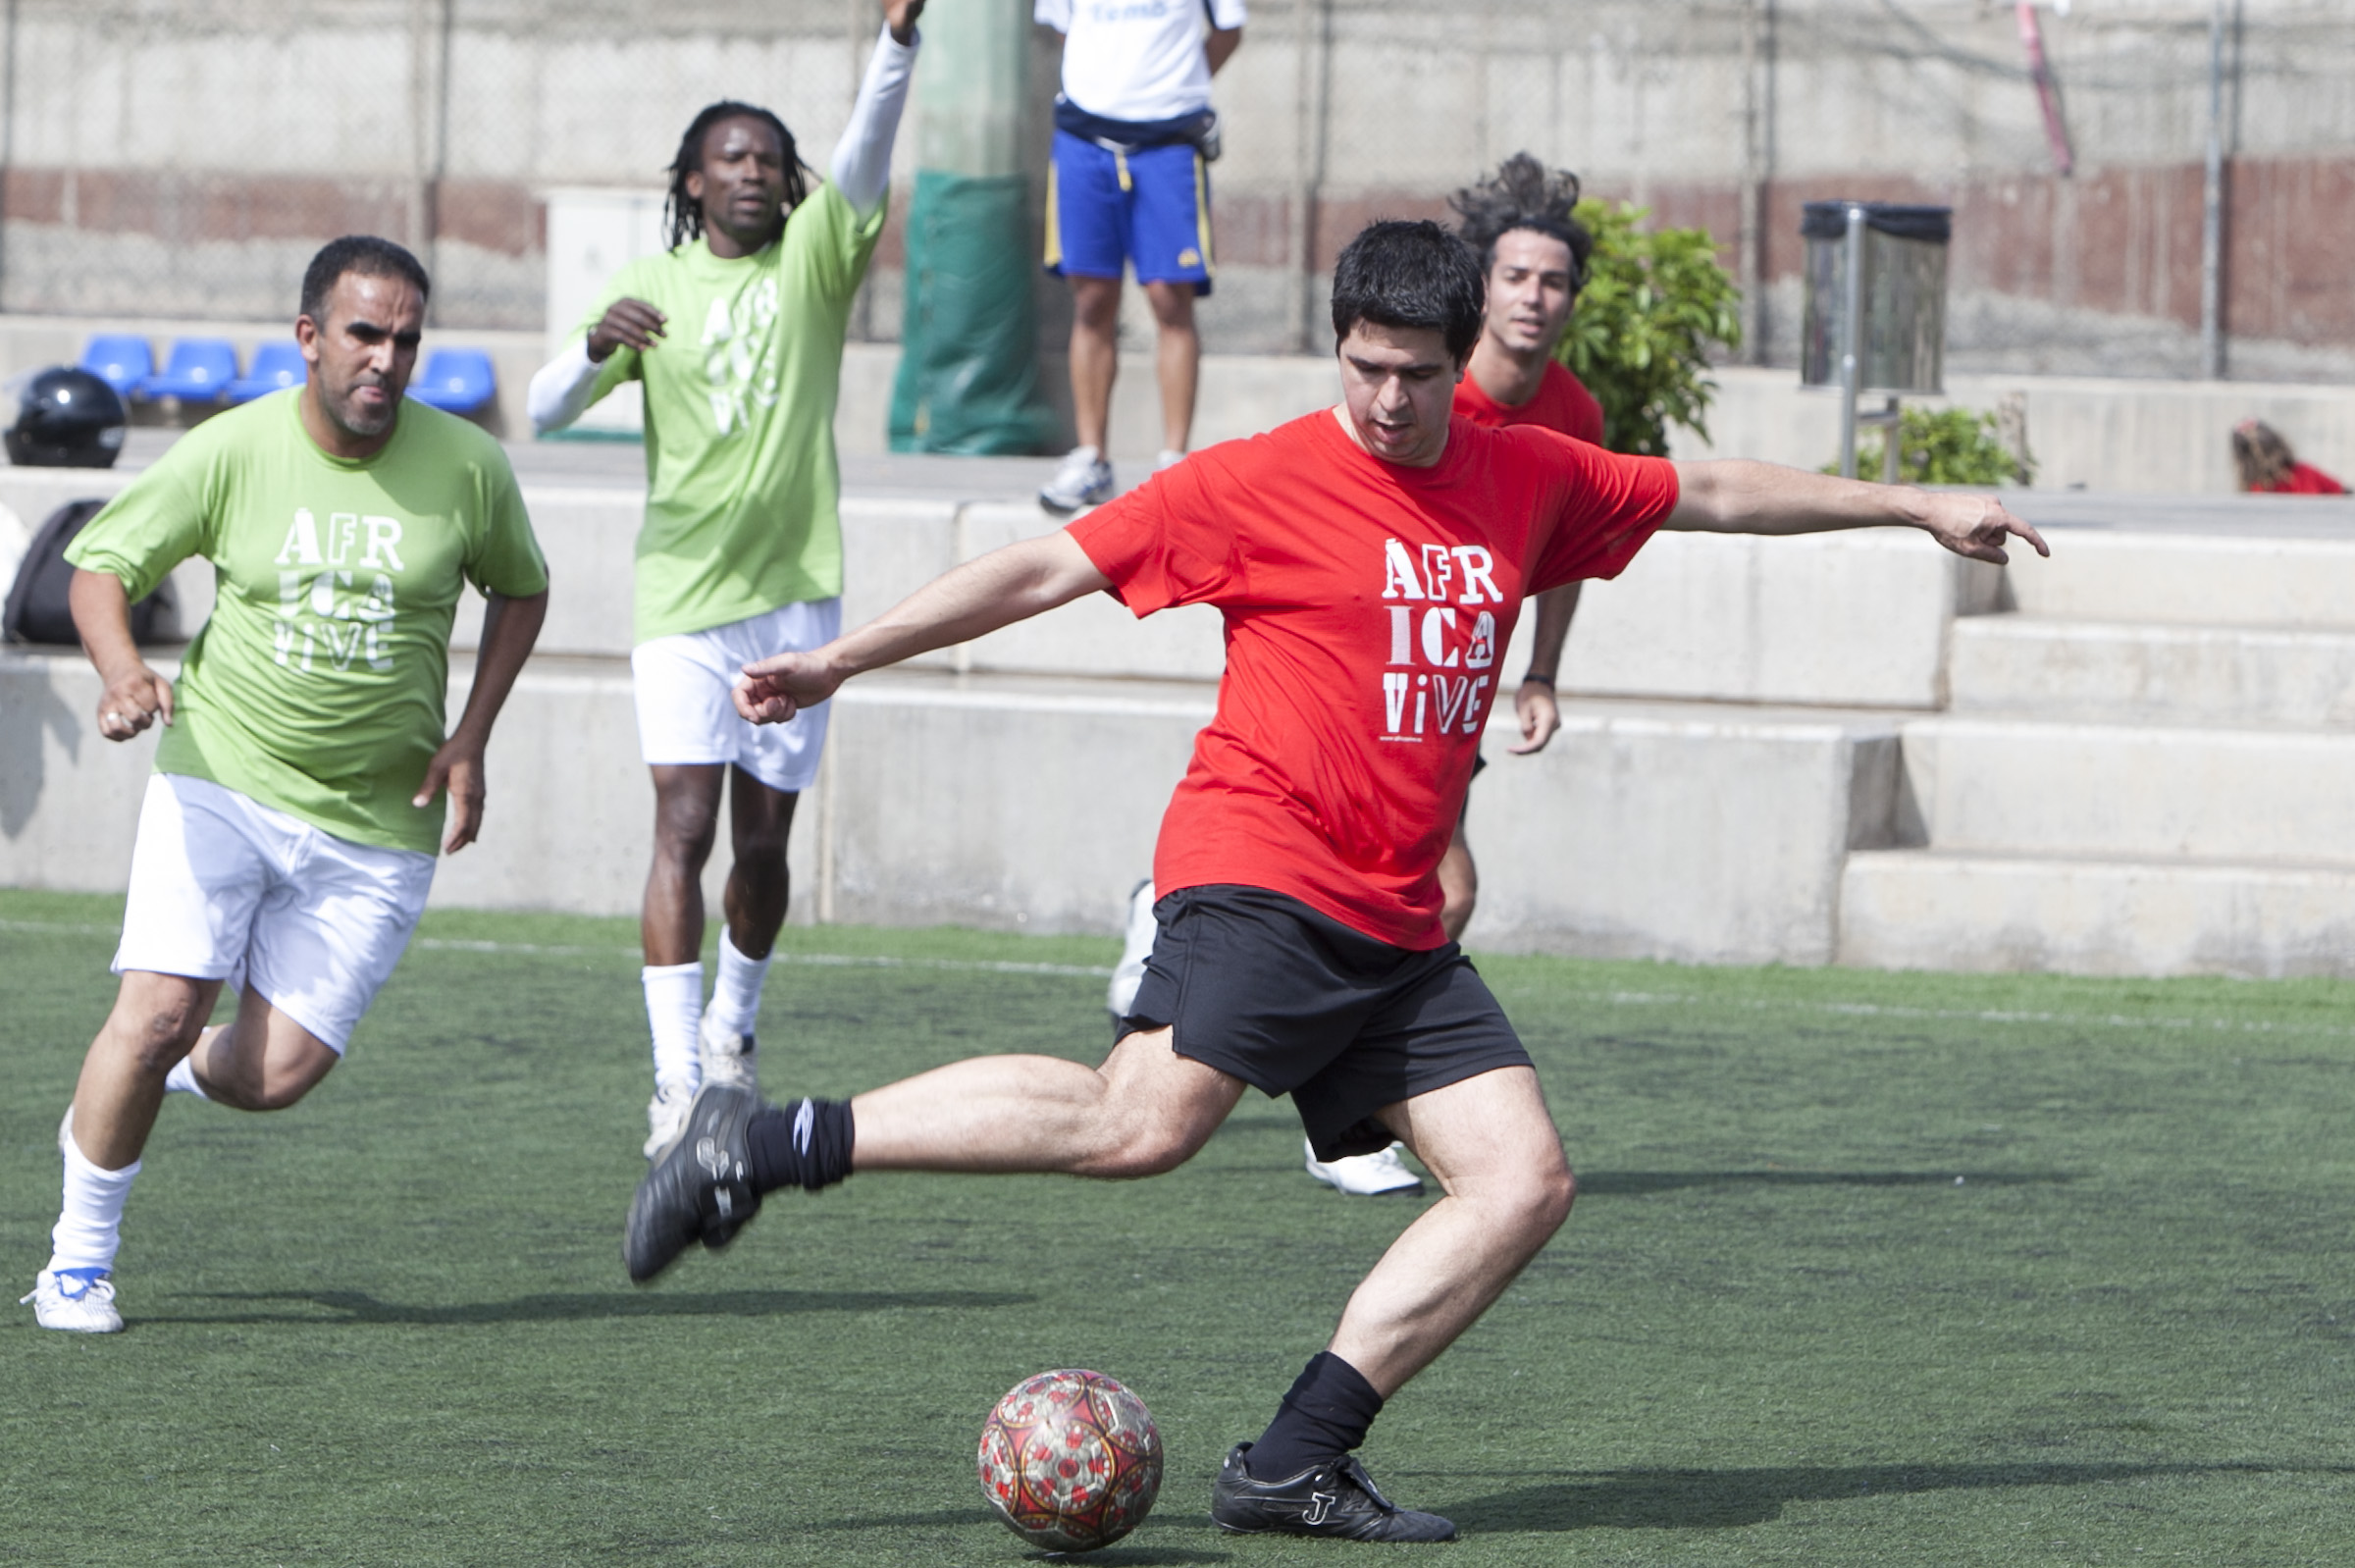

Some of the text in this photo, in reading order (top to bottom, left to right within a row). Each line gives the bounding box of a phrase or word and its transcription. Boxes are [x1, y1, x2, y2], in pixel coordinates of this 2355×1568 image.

[274, 507, 404, 571] AFR
[1382, 538, 1504, 604] AFR
[1384, 604, 1495, 668] ICA
